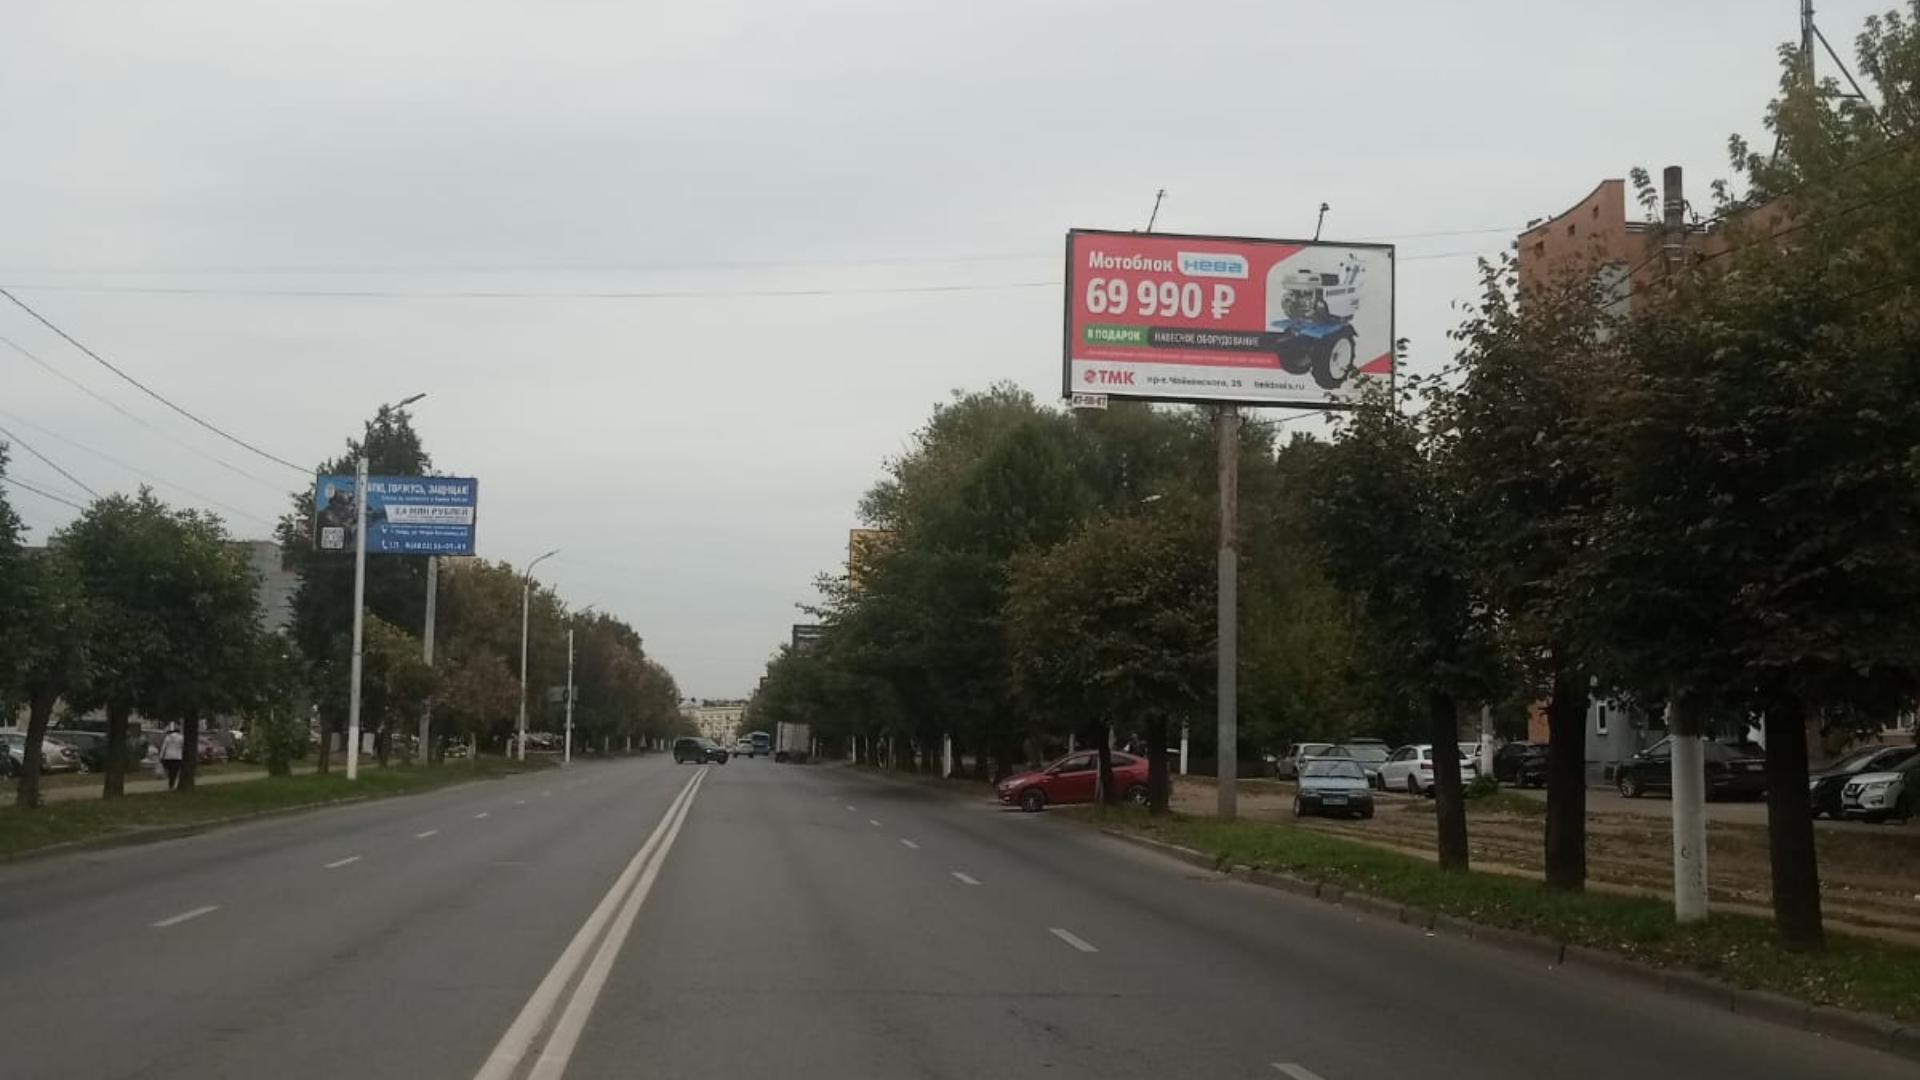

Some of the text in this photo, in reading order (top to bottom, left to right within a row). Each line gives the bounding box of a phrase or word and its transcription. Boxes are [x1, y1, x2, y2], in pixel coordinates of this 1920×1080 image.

[1088, 250, 1173, 274] Мотоблок
[1086, 278, 1128, 315] 69
[1137, 281, 1202, 319] 990
[1087, 329, 1141, 342] В ПОДАРОК
[1154, 331, 1260, 348] НАВЕСНОЕ ОБОРУДОВАНИЕ
[1098, 369, 1136, 385] ТМК
